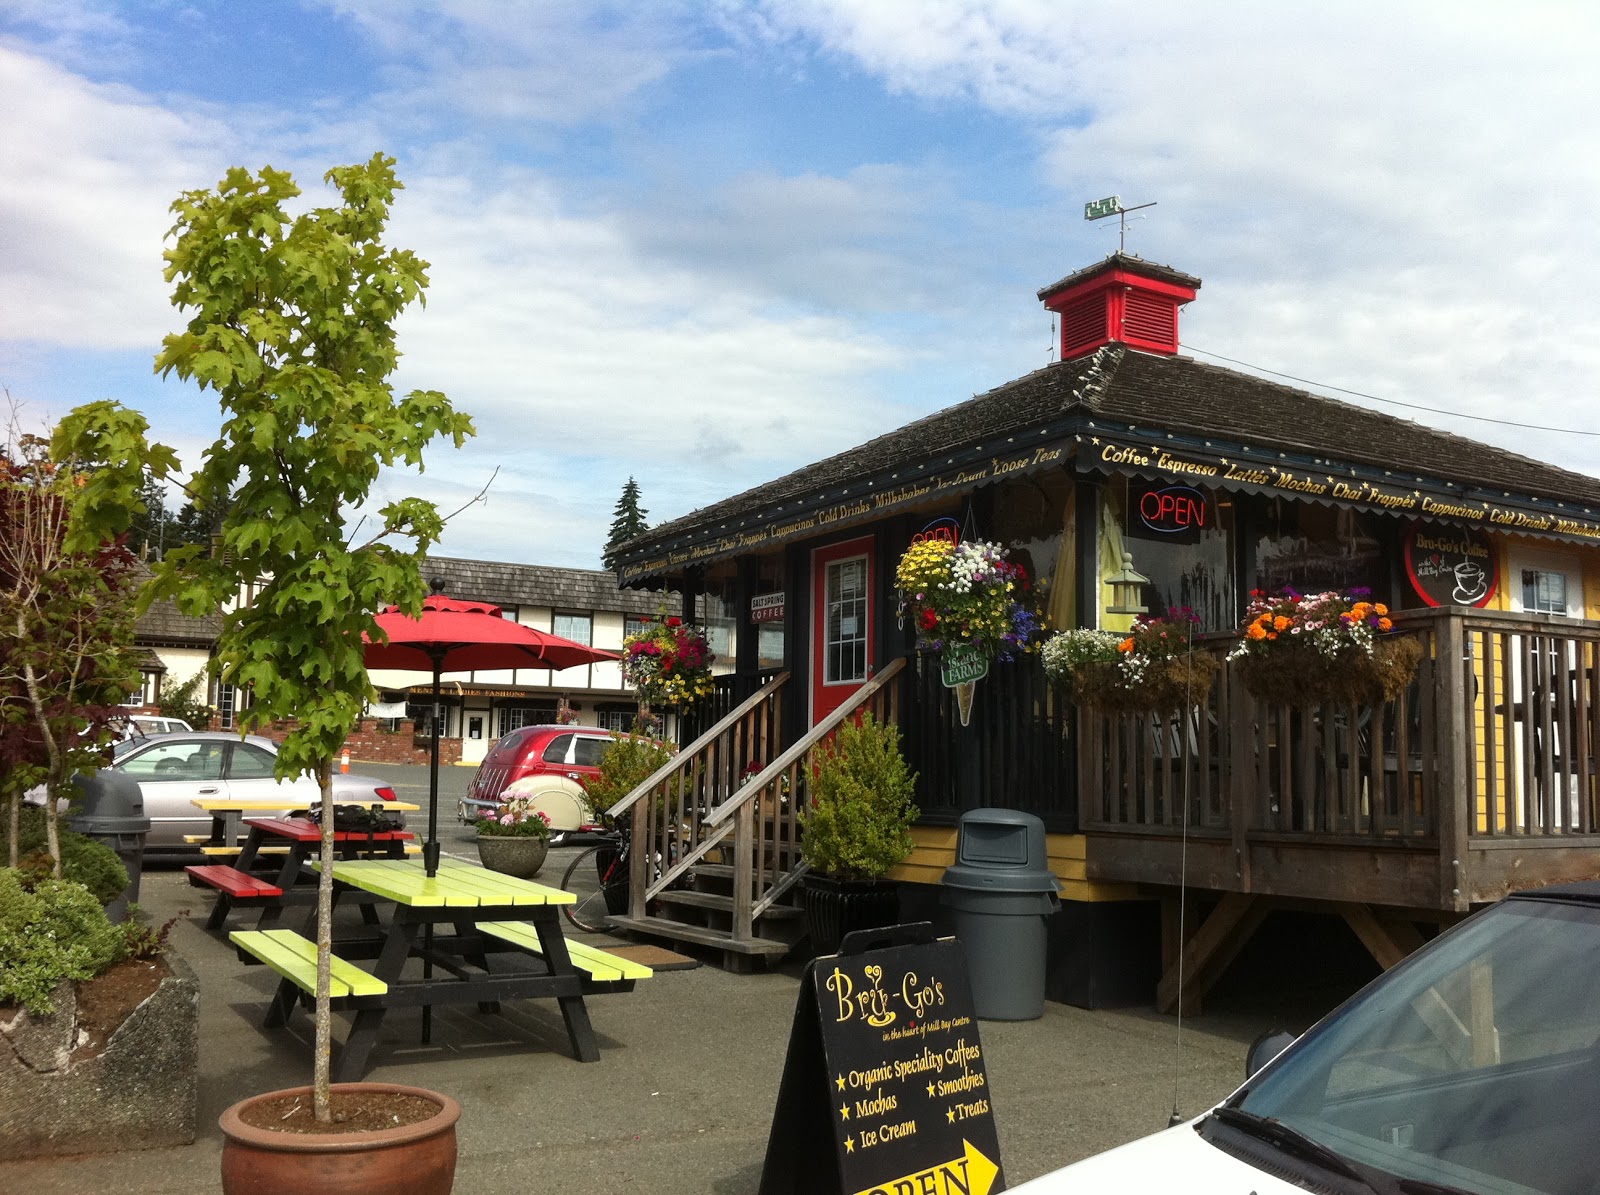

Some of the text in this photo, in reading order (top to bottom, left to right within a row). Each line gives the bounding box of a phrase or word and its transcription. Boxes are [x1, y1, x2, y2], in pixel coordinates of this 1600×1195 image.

[818, 505, 838, 525] Cold
[839, 501, 870, 520] Drinks
[993, 458, 1030, 476] Loose
[1031, 447, 1062, 465] Teas
[1101, 444, 1149, 466] Coffee
[1157, 452, 1217, 477] Espresso
[1224, 463, 1270, 485] Lattés
[1274, 472, 1327, 495] Mochas
[1332, 482, 1362, 500] Chai
[1366, 488, 1416, 508] Frappés
[1421, 496, 1485, 520] Cappucinos
[1489, 508, 1515, 525] Cold
[1514, 513, 1552, 531] Drinks
[1140, 491, 1205, 527] OPEN
[752, 597, 764, 608] SALT
[752, 607, 784, 620] COFFEE
[948, 661, 983, 682] FARMS
[826, 966, 945, 1024] Bru-Go's
[891, 1027, 902, 1040] the
[927, 1019, 940, 1032] Mill
[849, 1038, 980, 1091] Organic Speciality Coffees
[937, 1068, 984, 1097] Smoothies
[855, 1088, 897, 1119] Mochas
[955, 1098, 989, 1121] Treats
[860, 1119, 916, 1149] Ice Cream
[867, 1159, 971, 1195] EN
